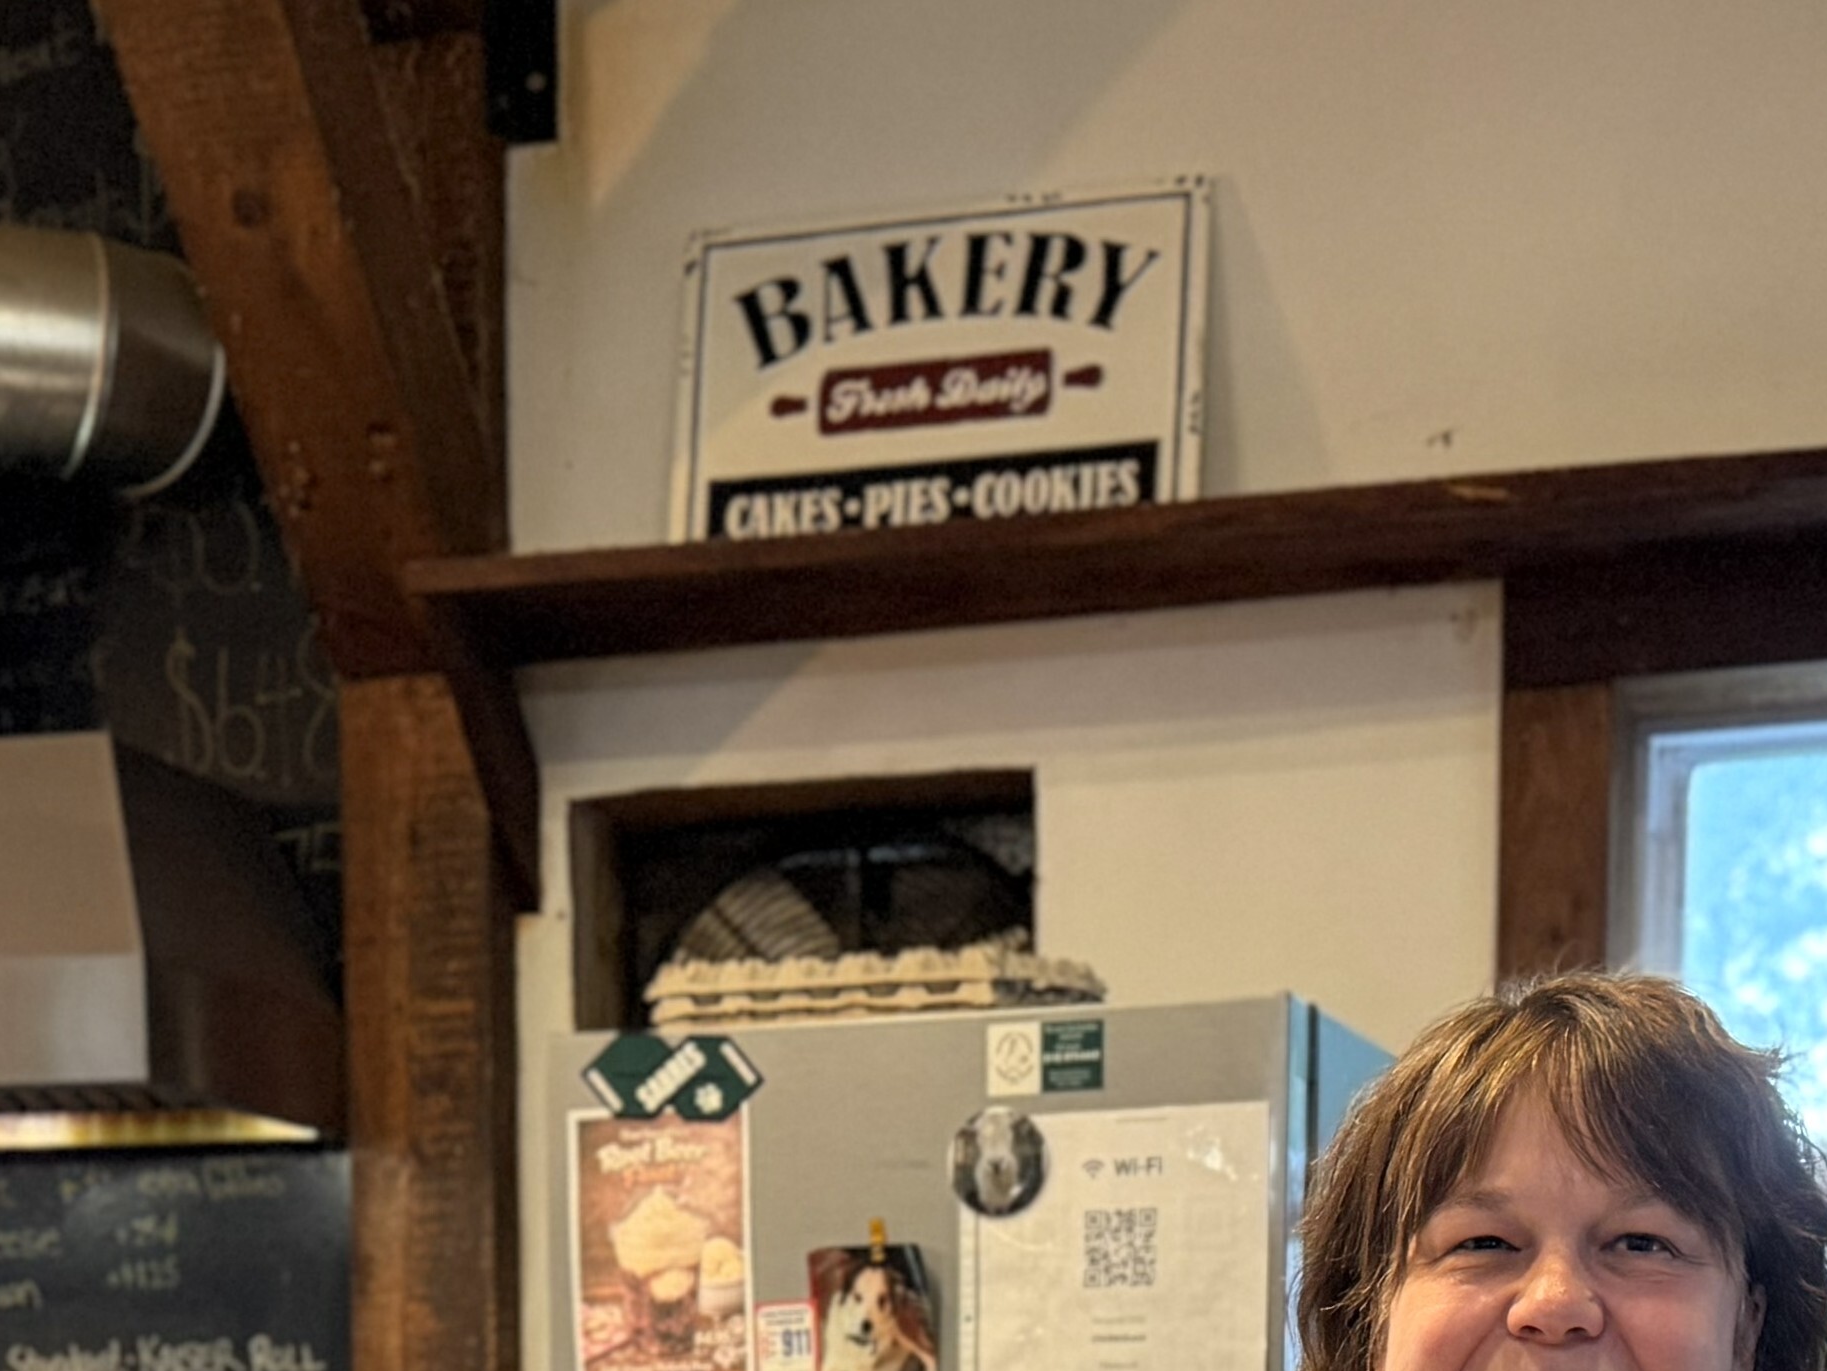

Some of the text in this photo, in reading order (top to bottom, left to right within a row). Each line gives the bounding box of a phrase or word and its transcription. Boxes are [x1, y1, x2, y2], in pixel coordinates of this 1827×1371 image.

[733, 231, 1161, 370] BAKERY
[825, 365, 1047, 423] Fresh Daily
[725, 459, 1141, 541] CAKES PIES COOKIES
[1113, 1156, 1164, 1178] Wi-Fi
[782, 1329, 812, 1357] 911
